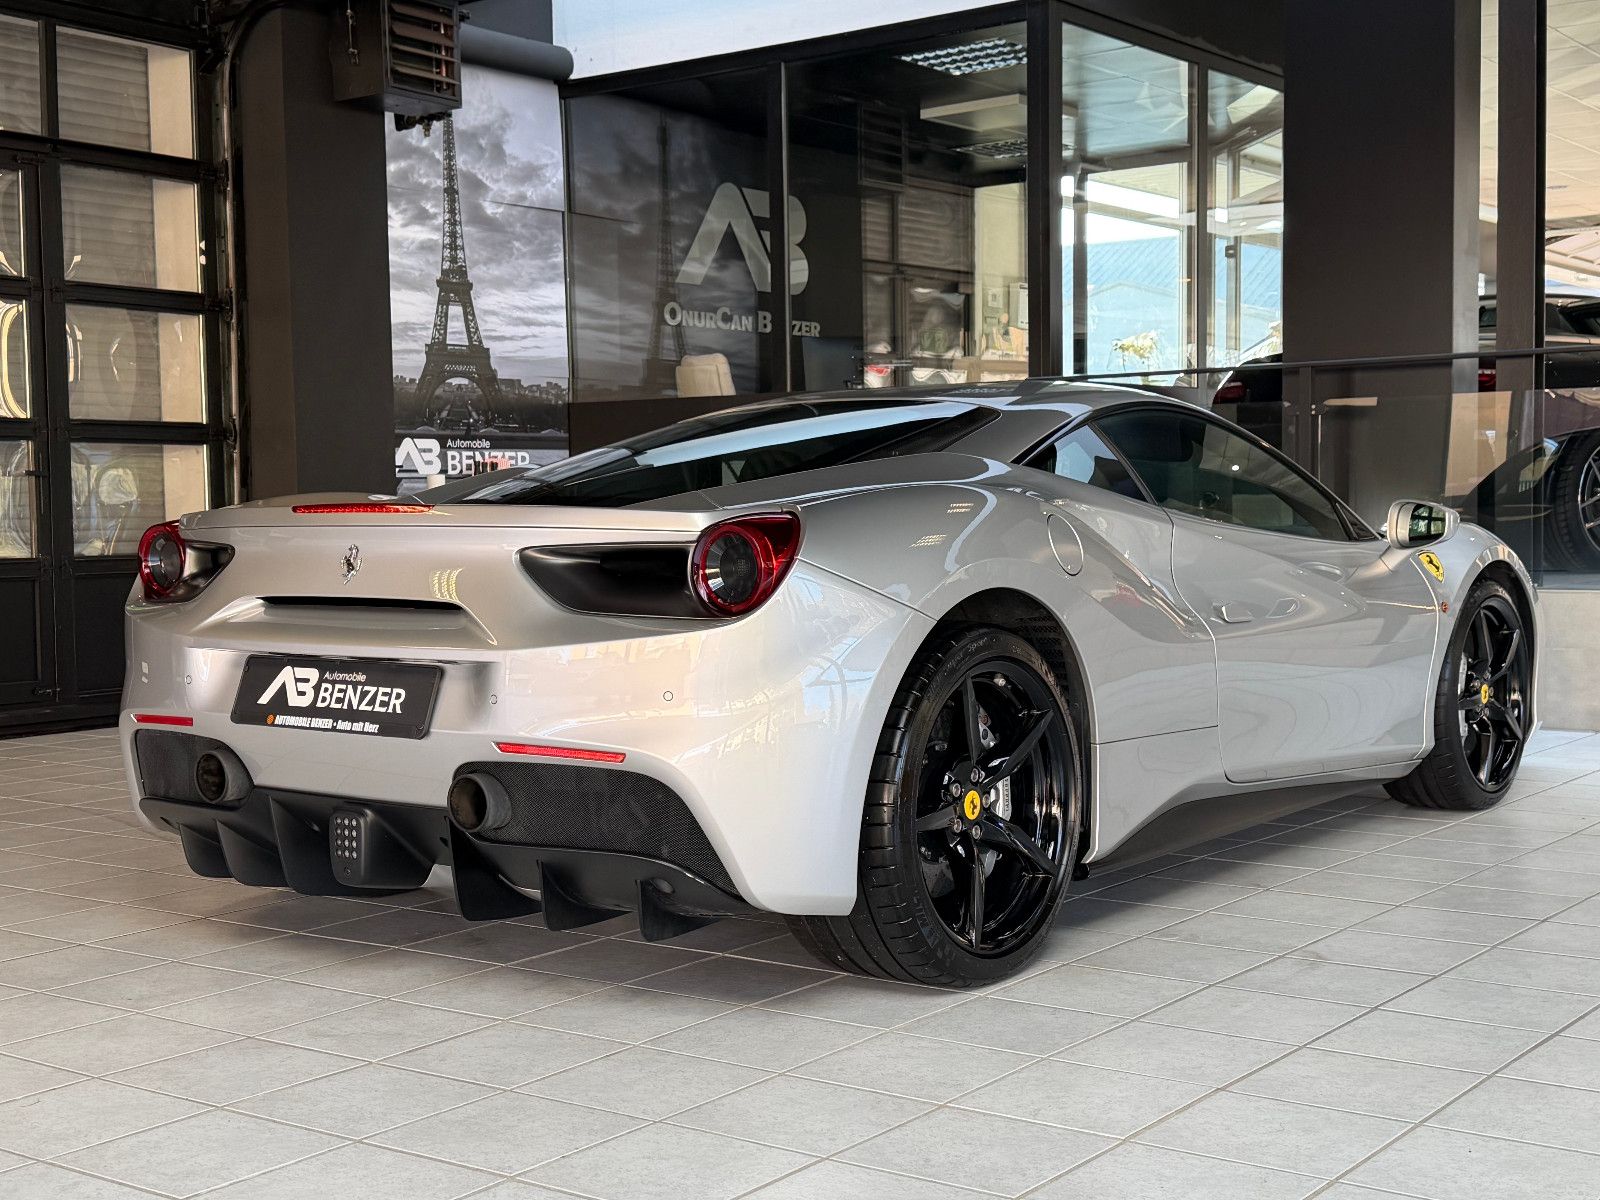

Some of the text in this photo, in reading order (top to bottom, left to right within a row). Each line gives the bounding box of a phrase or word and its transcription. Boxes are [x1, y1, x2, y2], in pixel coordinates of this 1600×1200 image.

[757, 310, 821, 337] BZER
[395, 437, 442, 475] AB
[446, 438, 491, 449] Automobile
[256, 665, 320, 708] AB
[323, 670, 367, 683] Automobile
[315, 682, 406, 714] BENZER
[274, 714, 380, 733] AUTOMOBILE BENZER Auto mit Herz
